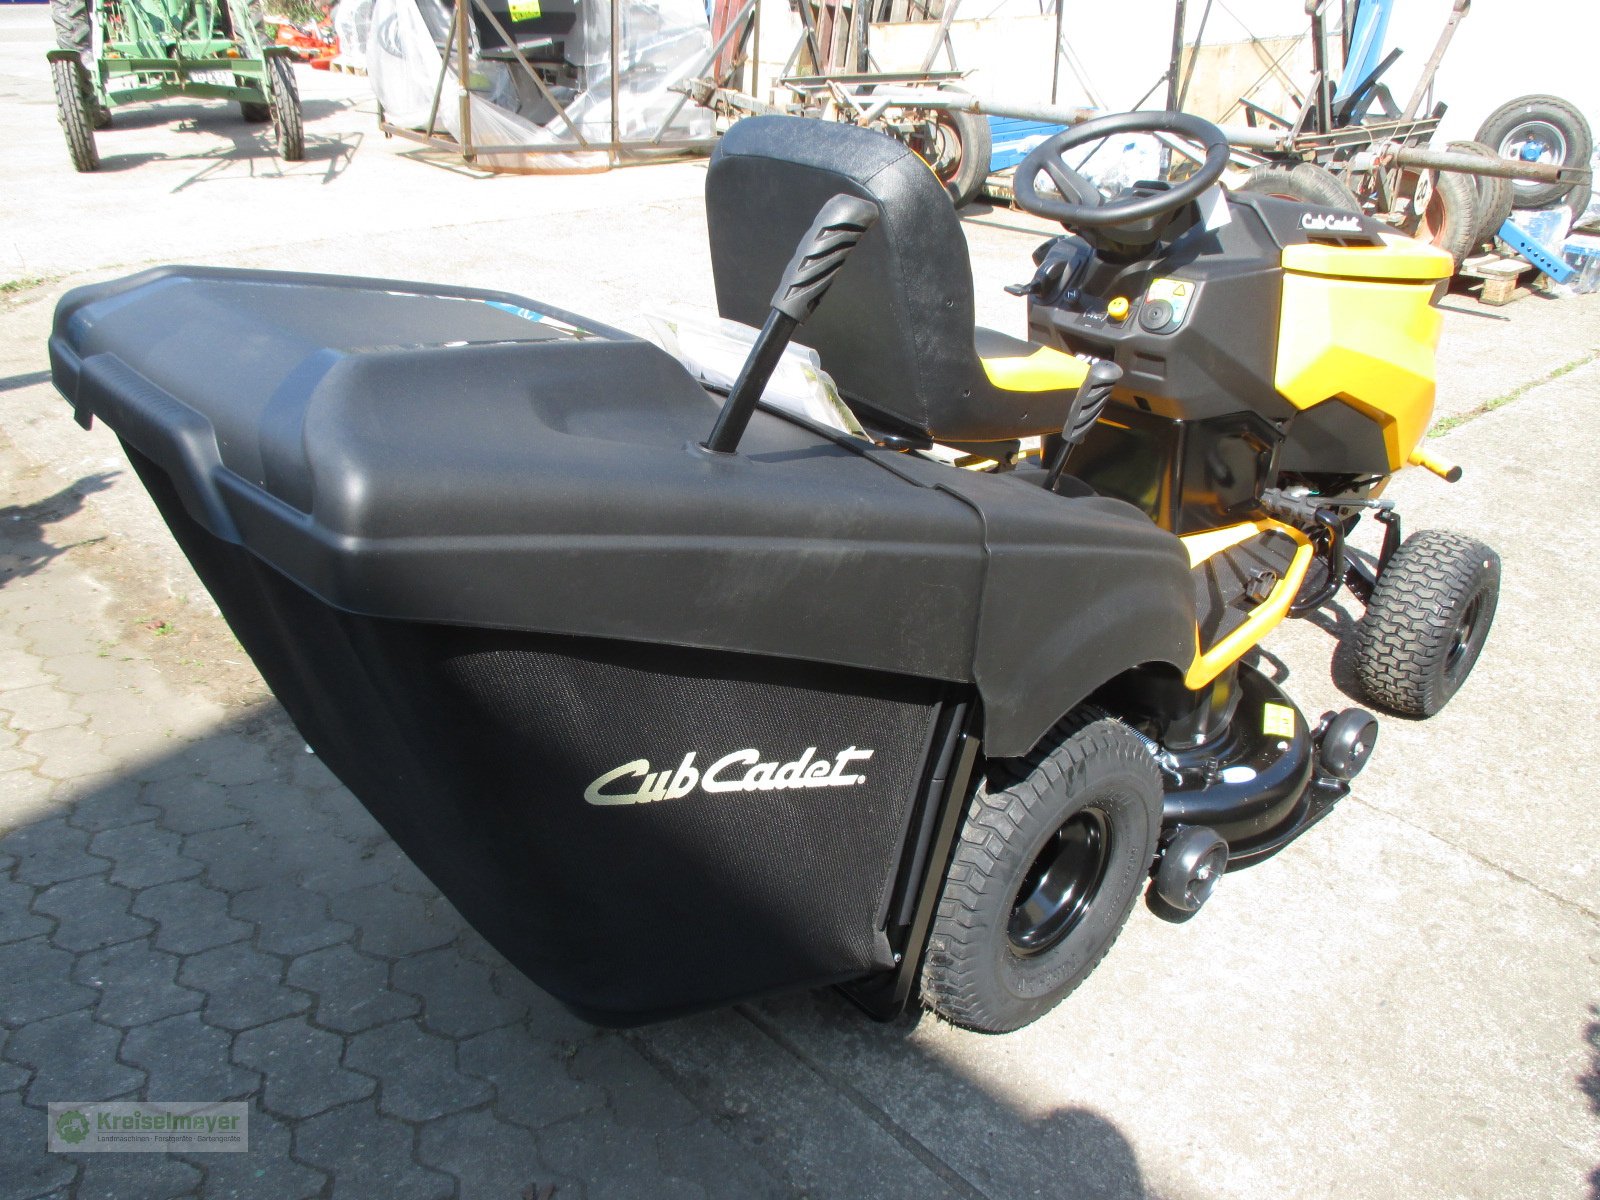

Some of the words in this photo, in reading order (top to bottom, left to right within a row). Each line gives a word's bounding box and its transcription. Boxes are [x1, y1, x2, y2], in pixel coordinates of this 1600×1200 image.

[1301, 213, 1325, 229] Cub
[584, 751, 700, 806] Cub
[701, 745, 874, 793] Cadet
